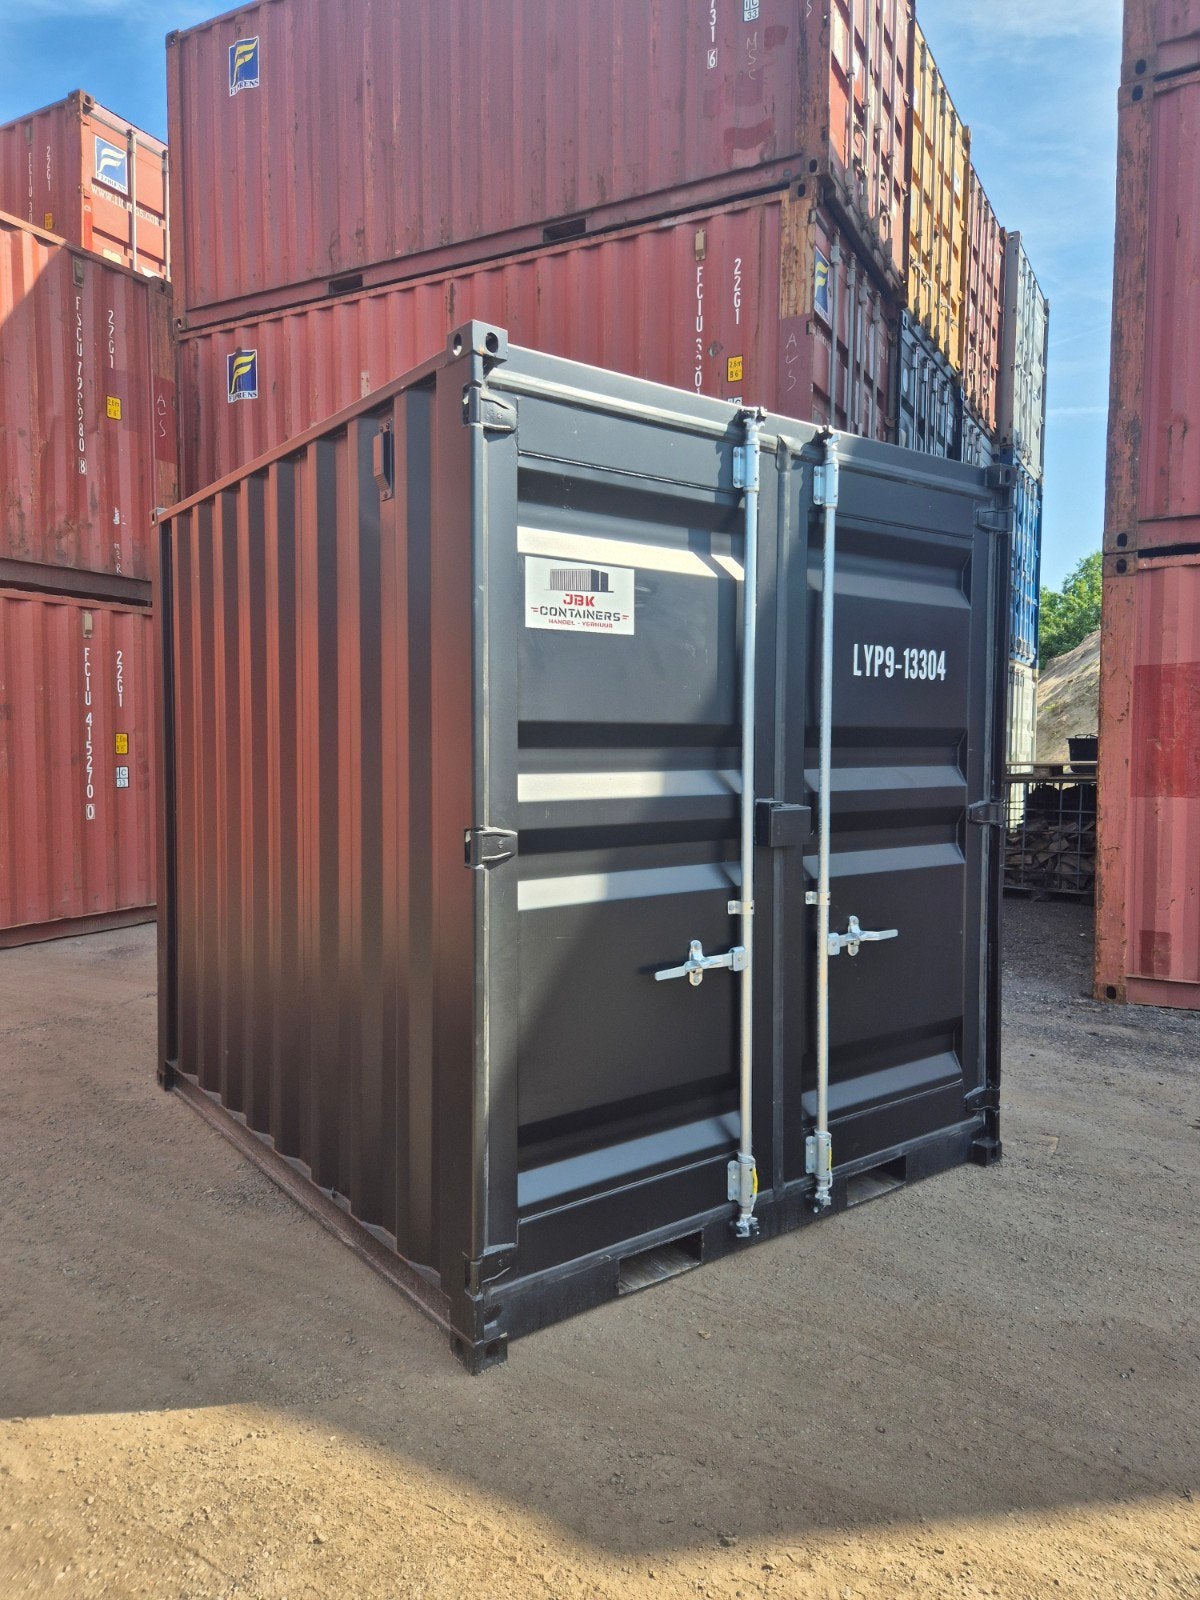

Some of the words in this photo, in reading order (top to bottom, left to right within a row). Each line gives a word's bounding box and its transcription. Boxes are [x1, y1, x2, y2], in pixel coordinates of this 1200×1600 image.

[696, 266, 704, 332] FCIU
[733, 258, 742, 324] 22G1
[540, 606, 621, 622] CONTAINERS
[548, 618, 575, 626] HANDEL
[582, 621, 613, 629] VERHUUR
[563, 593, 595, 607] JBK
[84, 648, 92, 705] FCIU
[853, 643, 946, 681] LYP9-13304
[85, 712, 93, 799] 415270
